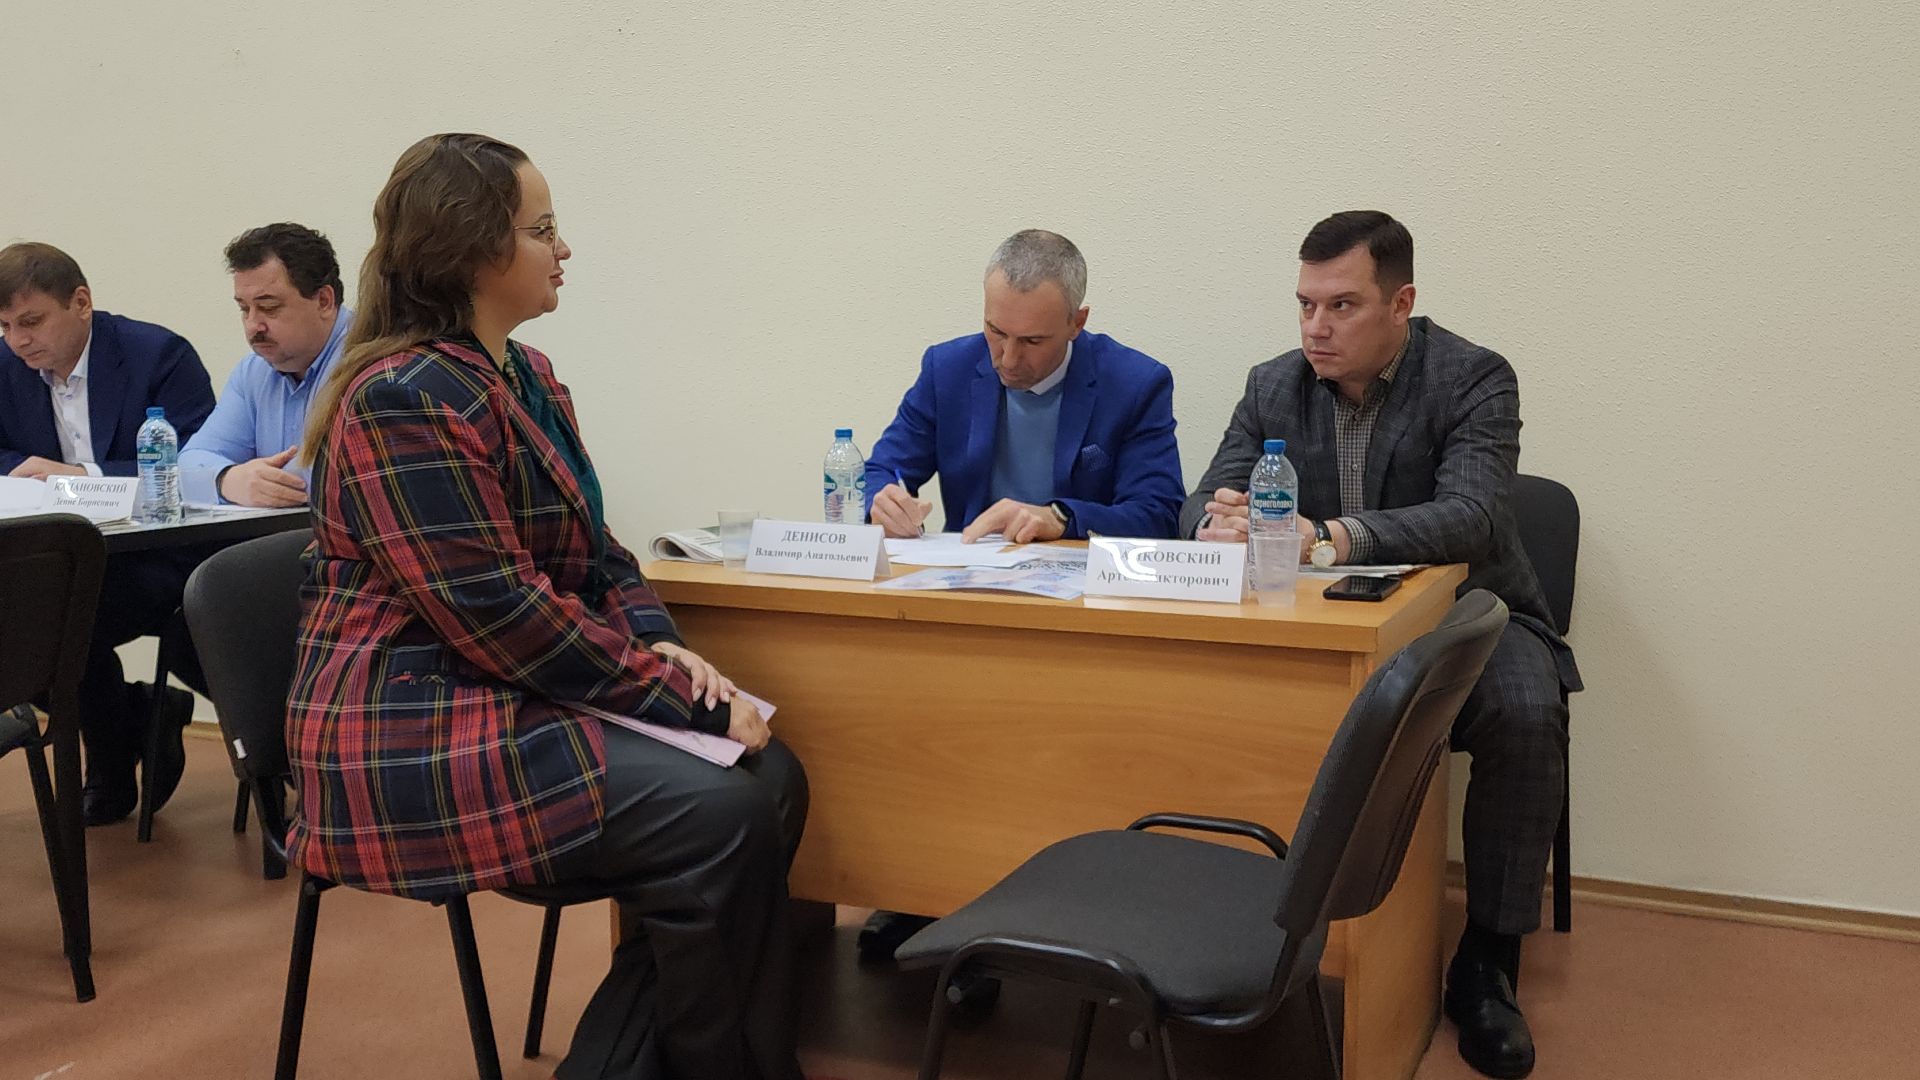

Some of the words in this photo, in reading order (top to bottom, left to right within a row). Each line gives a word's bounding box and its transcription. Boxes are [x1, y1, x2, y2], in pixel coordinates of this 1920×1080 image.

[781, 530, 847, 544] ДЕНИСОВ
[755, 547, 802, 560] Владимир
[805, 551, 869, 562] Анатольевич
